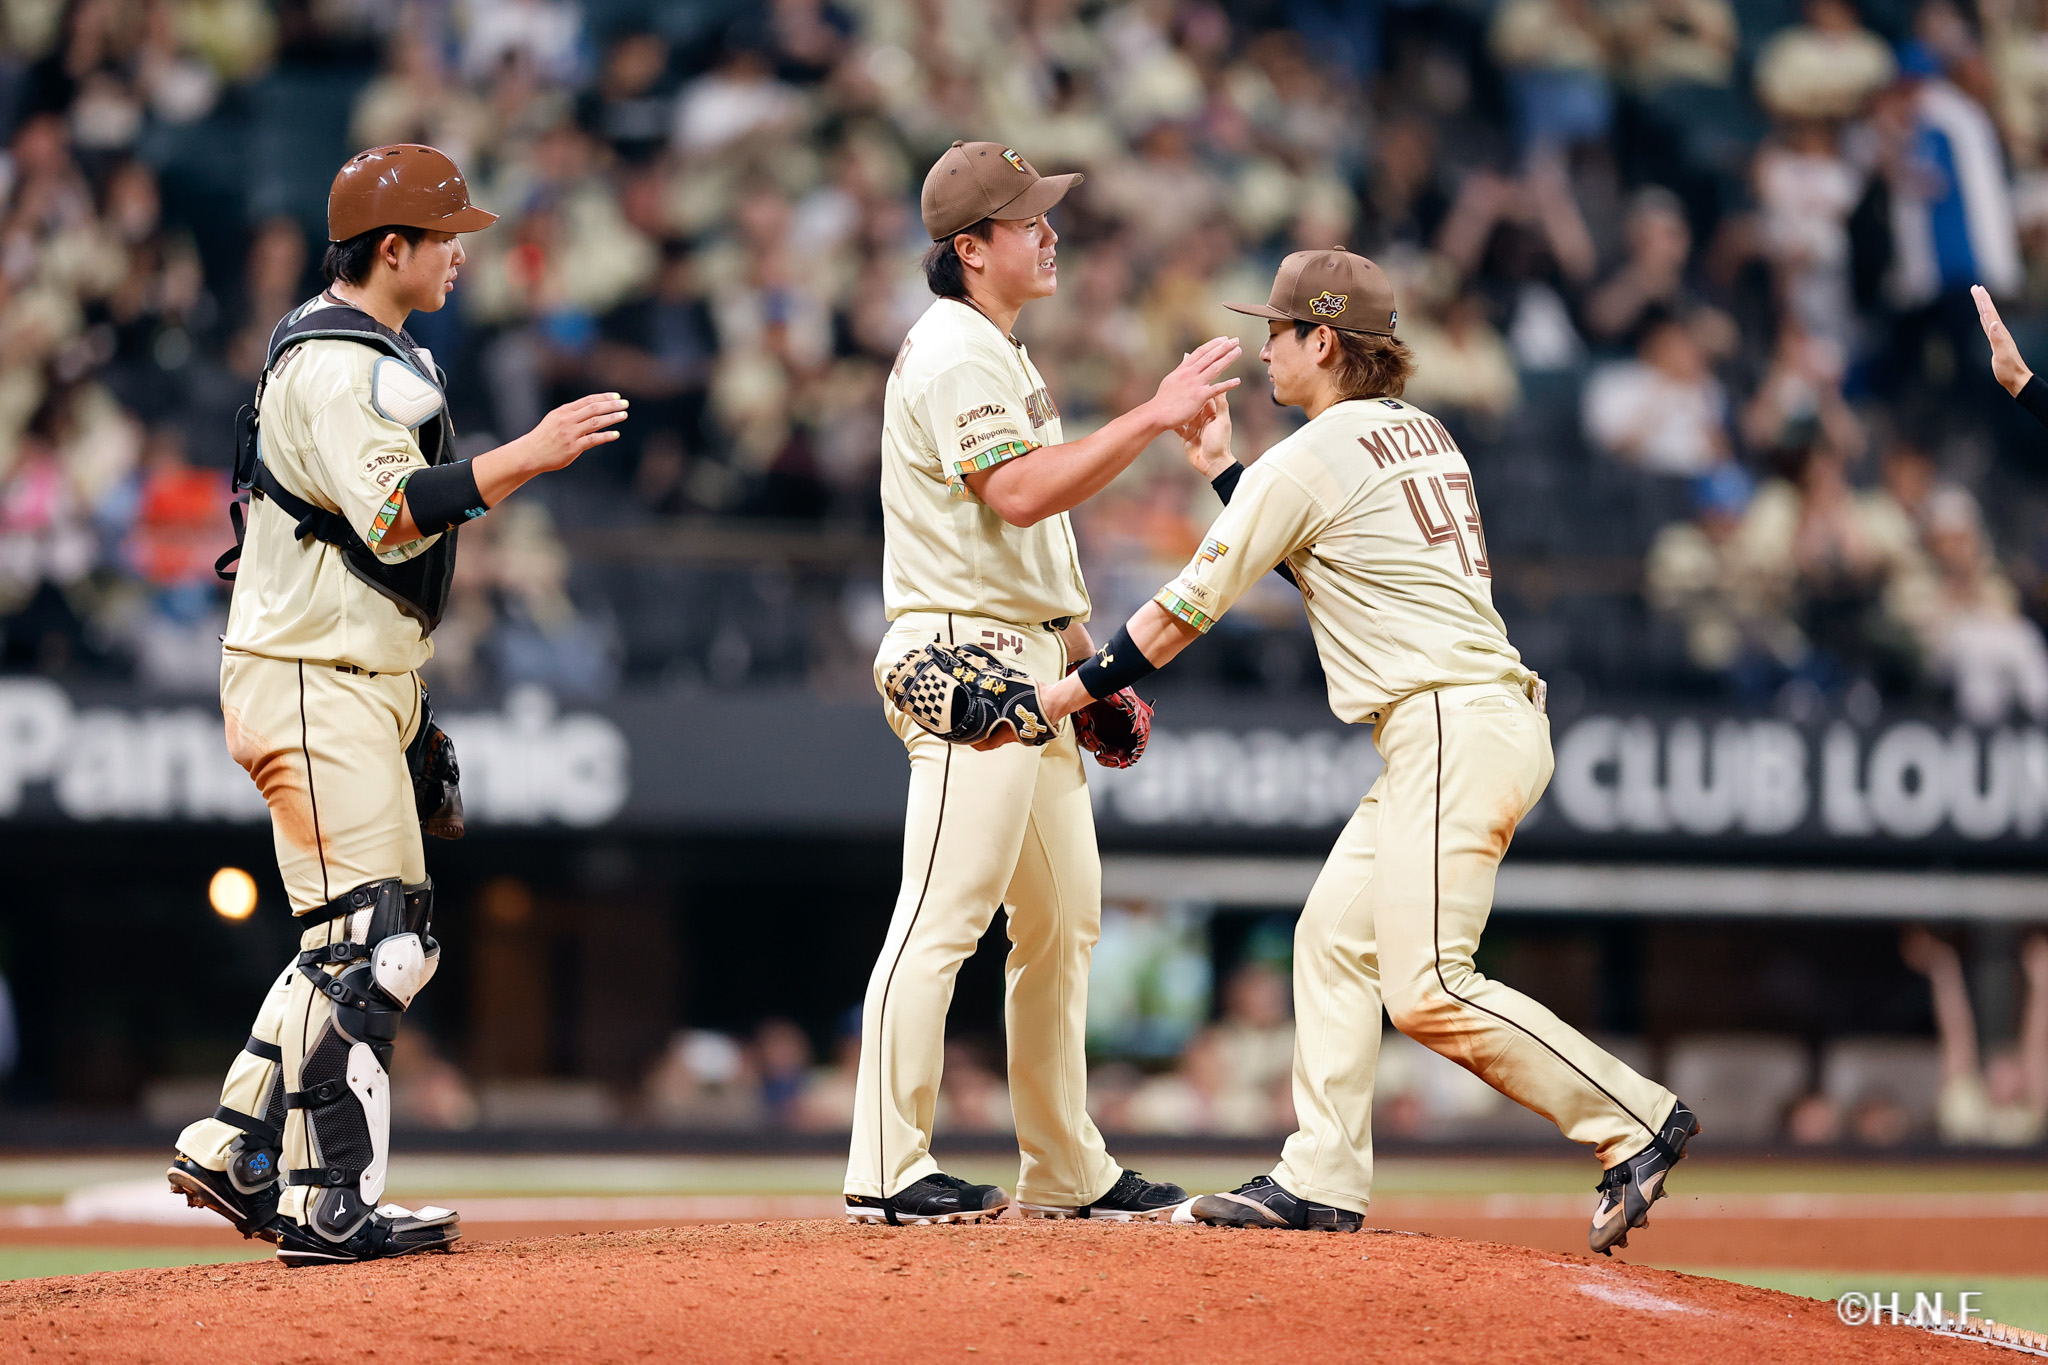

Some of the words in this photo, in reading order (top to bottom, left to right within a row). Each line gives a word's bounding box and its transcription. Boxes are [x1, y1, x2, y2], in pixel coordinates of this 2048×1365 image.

[967, 404, 1006, 422] ホクレン
[977, 428, 1019, 443] Nipponham
[374, 454, 410, 466] ホクレン
[1400, 472, 1492, 578] 43
[980, 630, 1023, 655] ニトリ
[0, 680, 630, 828] Pannic
[1556, 716, 1808, 836] CLUB
[249, 1153, 270, 1175] 33
